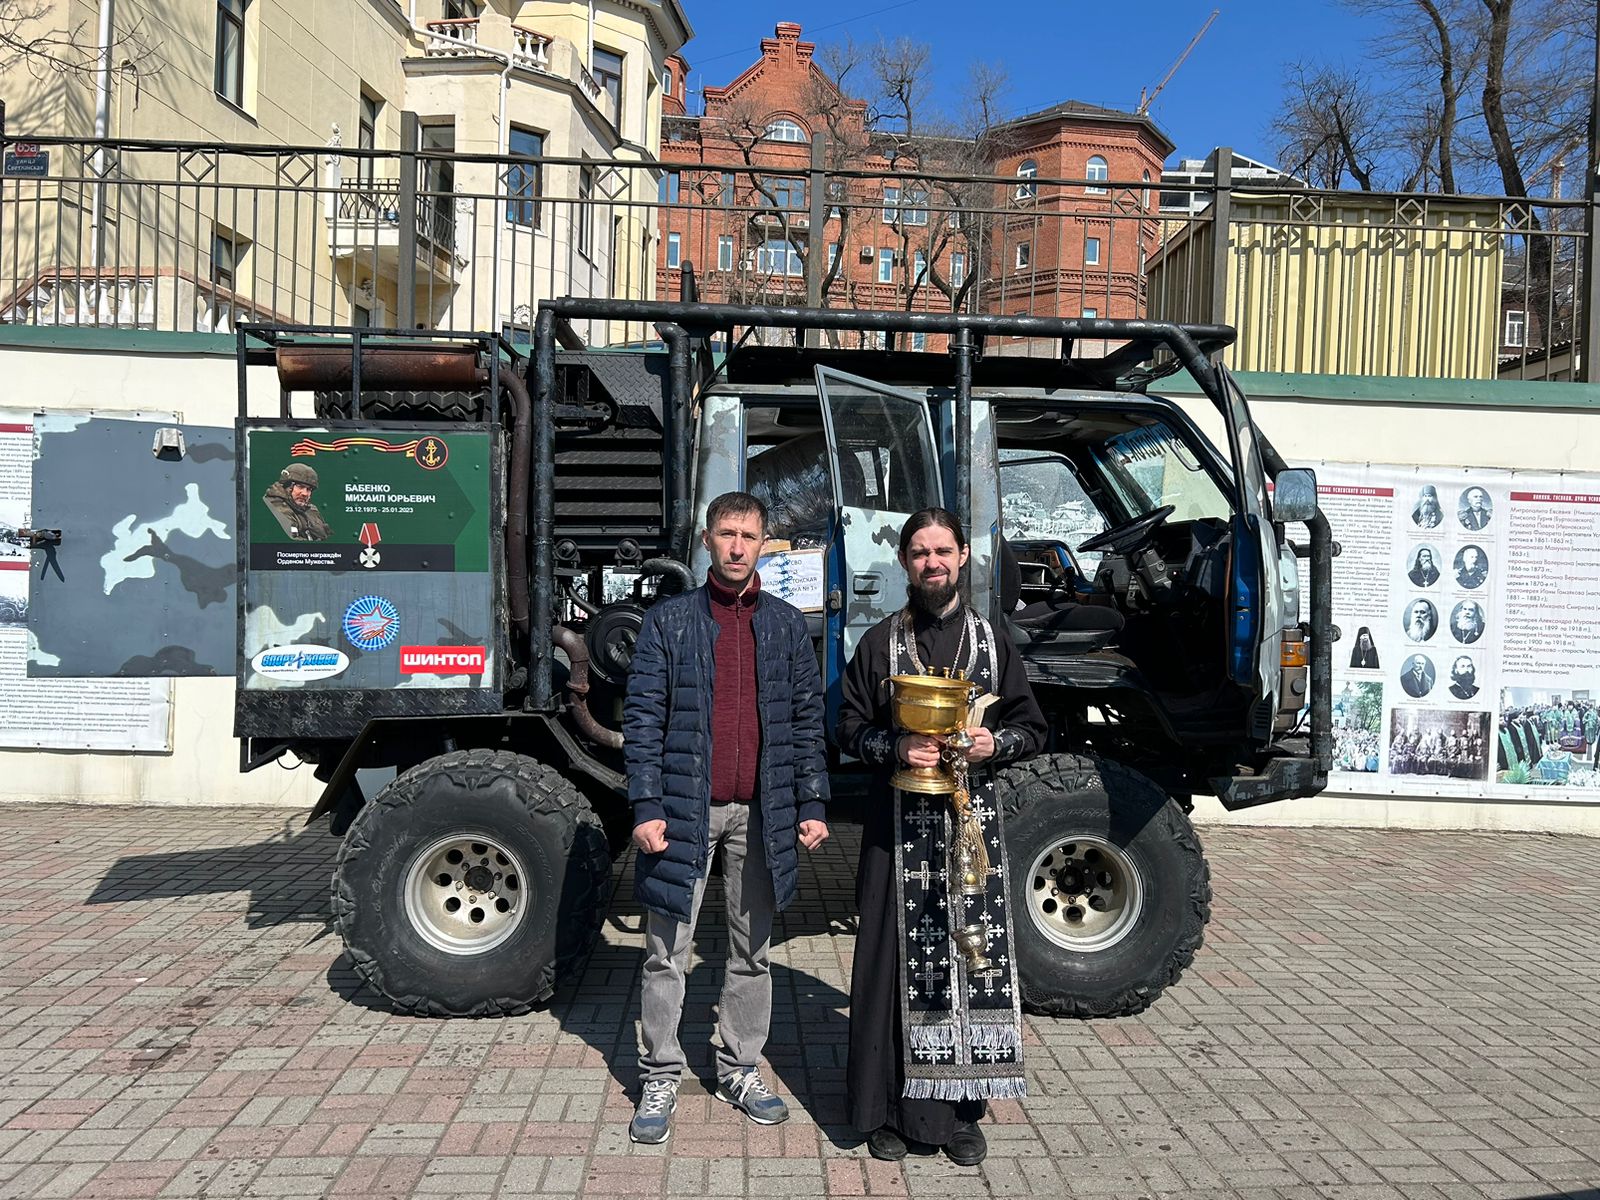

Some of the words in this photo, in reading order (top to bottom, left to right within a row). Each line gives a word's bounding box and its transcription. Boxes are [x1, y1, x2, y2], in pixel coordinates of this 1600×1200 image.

[345, 484, 391, 492] БАБЕНКО
[345, 494, 386, 502] МИХАИЛ
[387, 494, 436, 503] ЮРЬЕВИЧ
[276, 551, 309, 559] Посмертно
[403, 653, 482, 666] ШИНТОП
